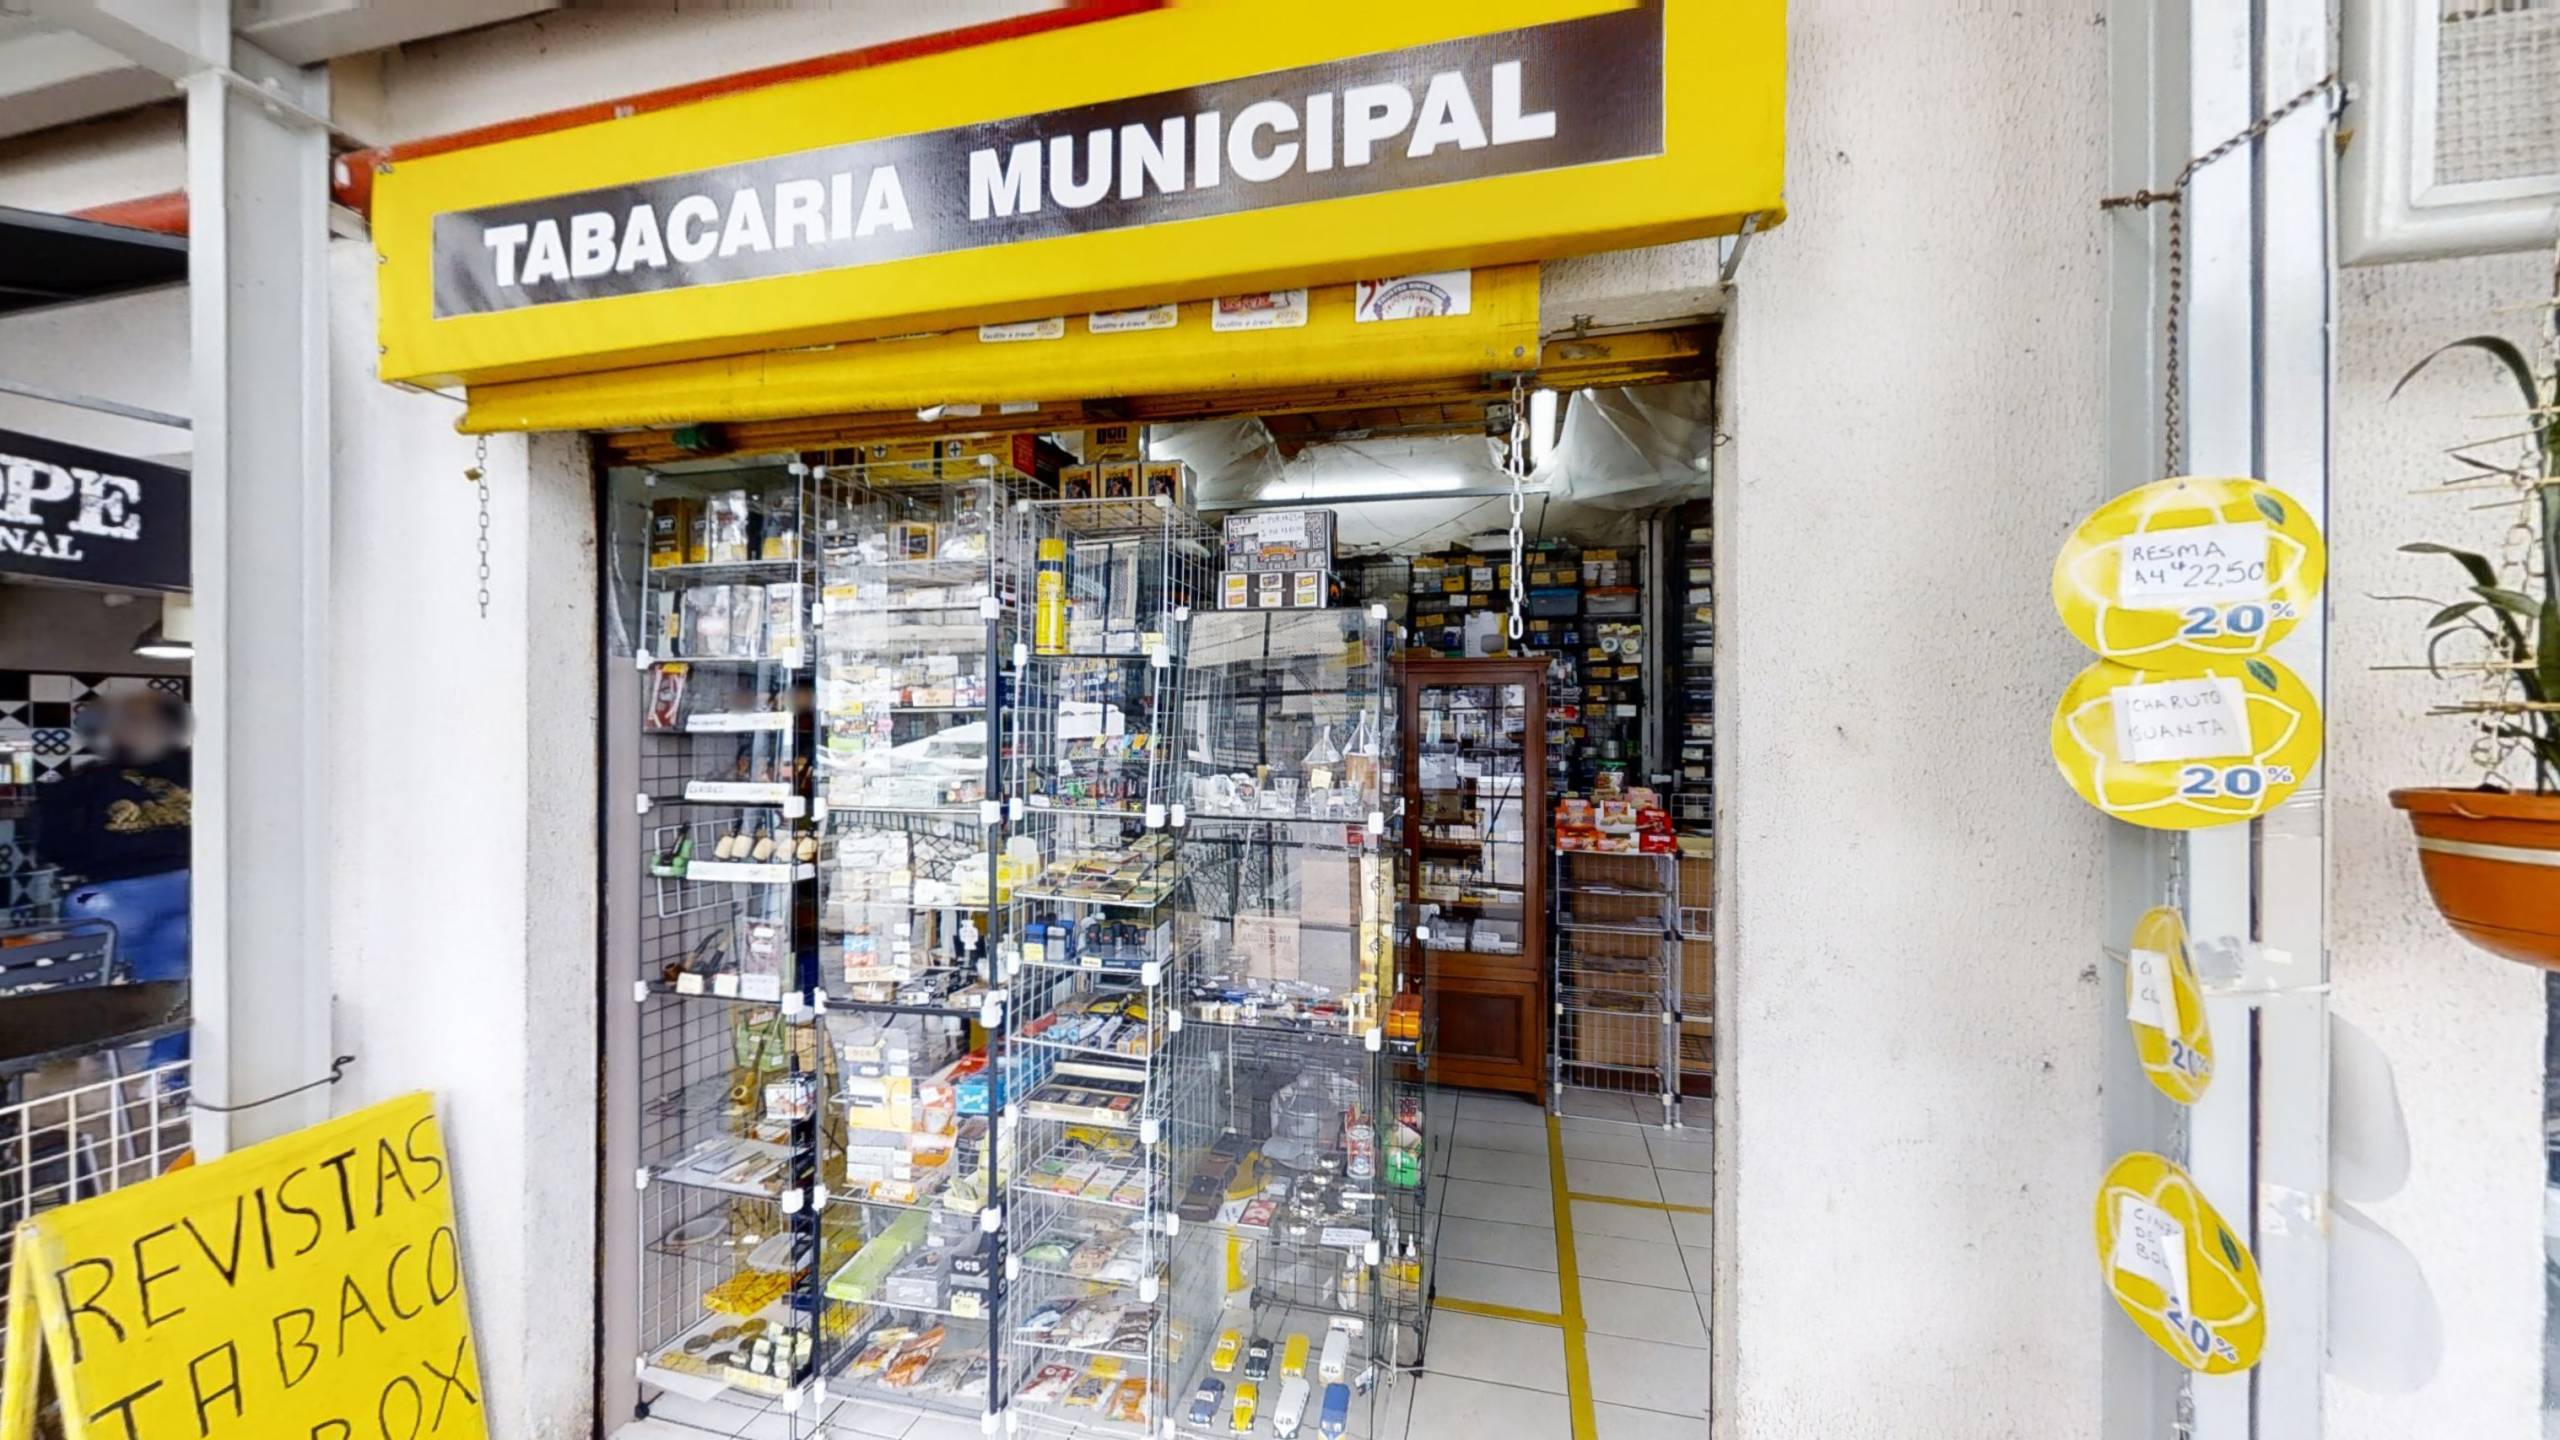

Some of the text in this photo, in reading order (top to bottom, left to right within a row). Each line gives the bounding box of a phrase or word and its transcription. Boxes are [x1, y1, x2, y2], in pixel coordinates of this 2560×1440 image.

[483, 60, 1556, 286] TABACARIA MUNICIPAL
[2132, 541, 2226, 562] RESMA
[56, 1114, 442, 1364] REVISTAS
[90, 1226, 459, 1440] TABACO
